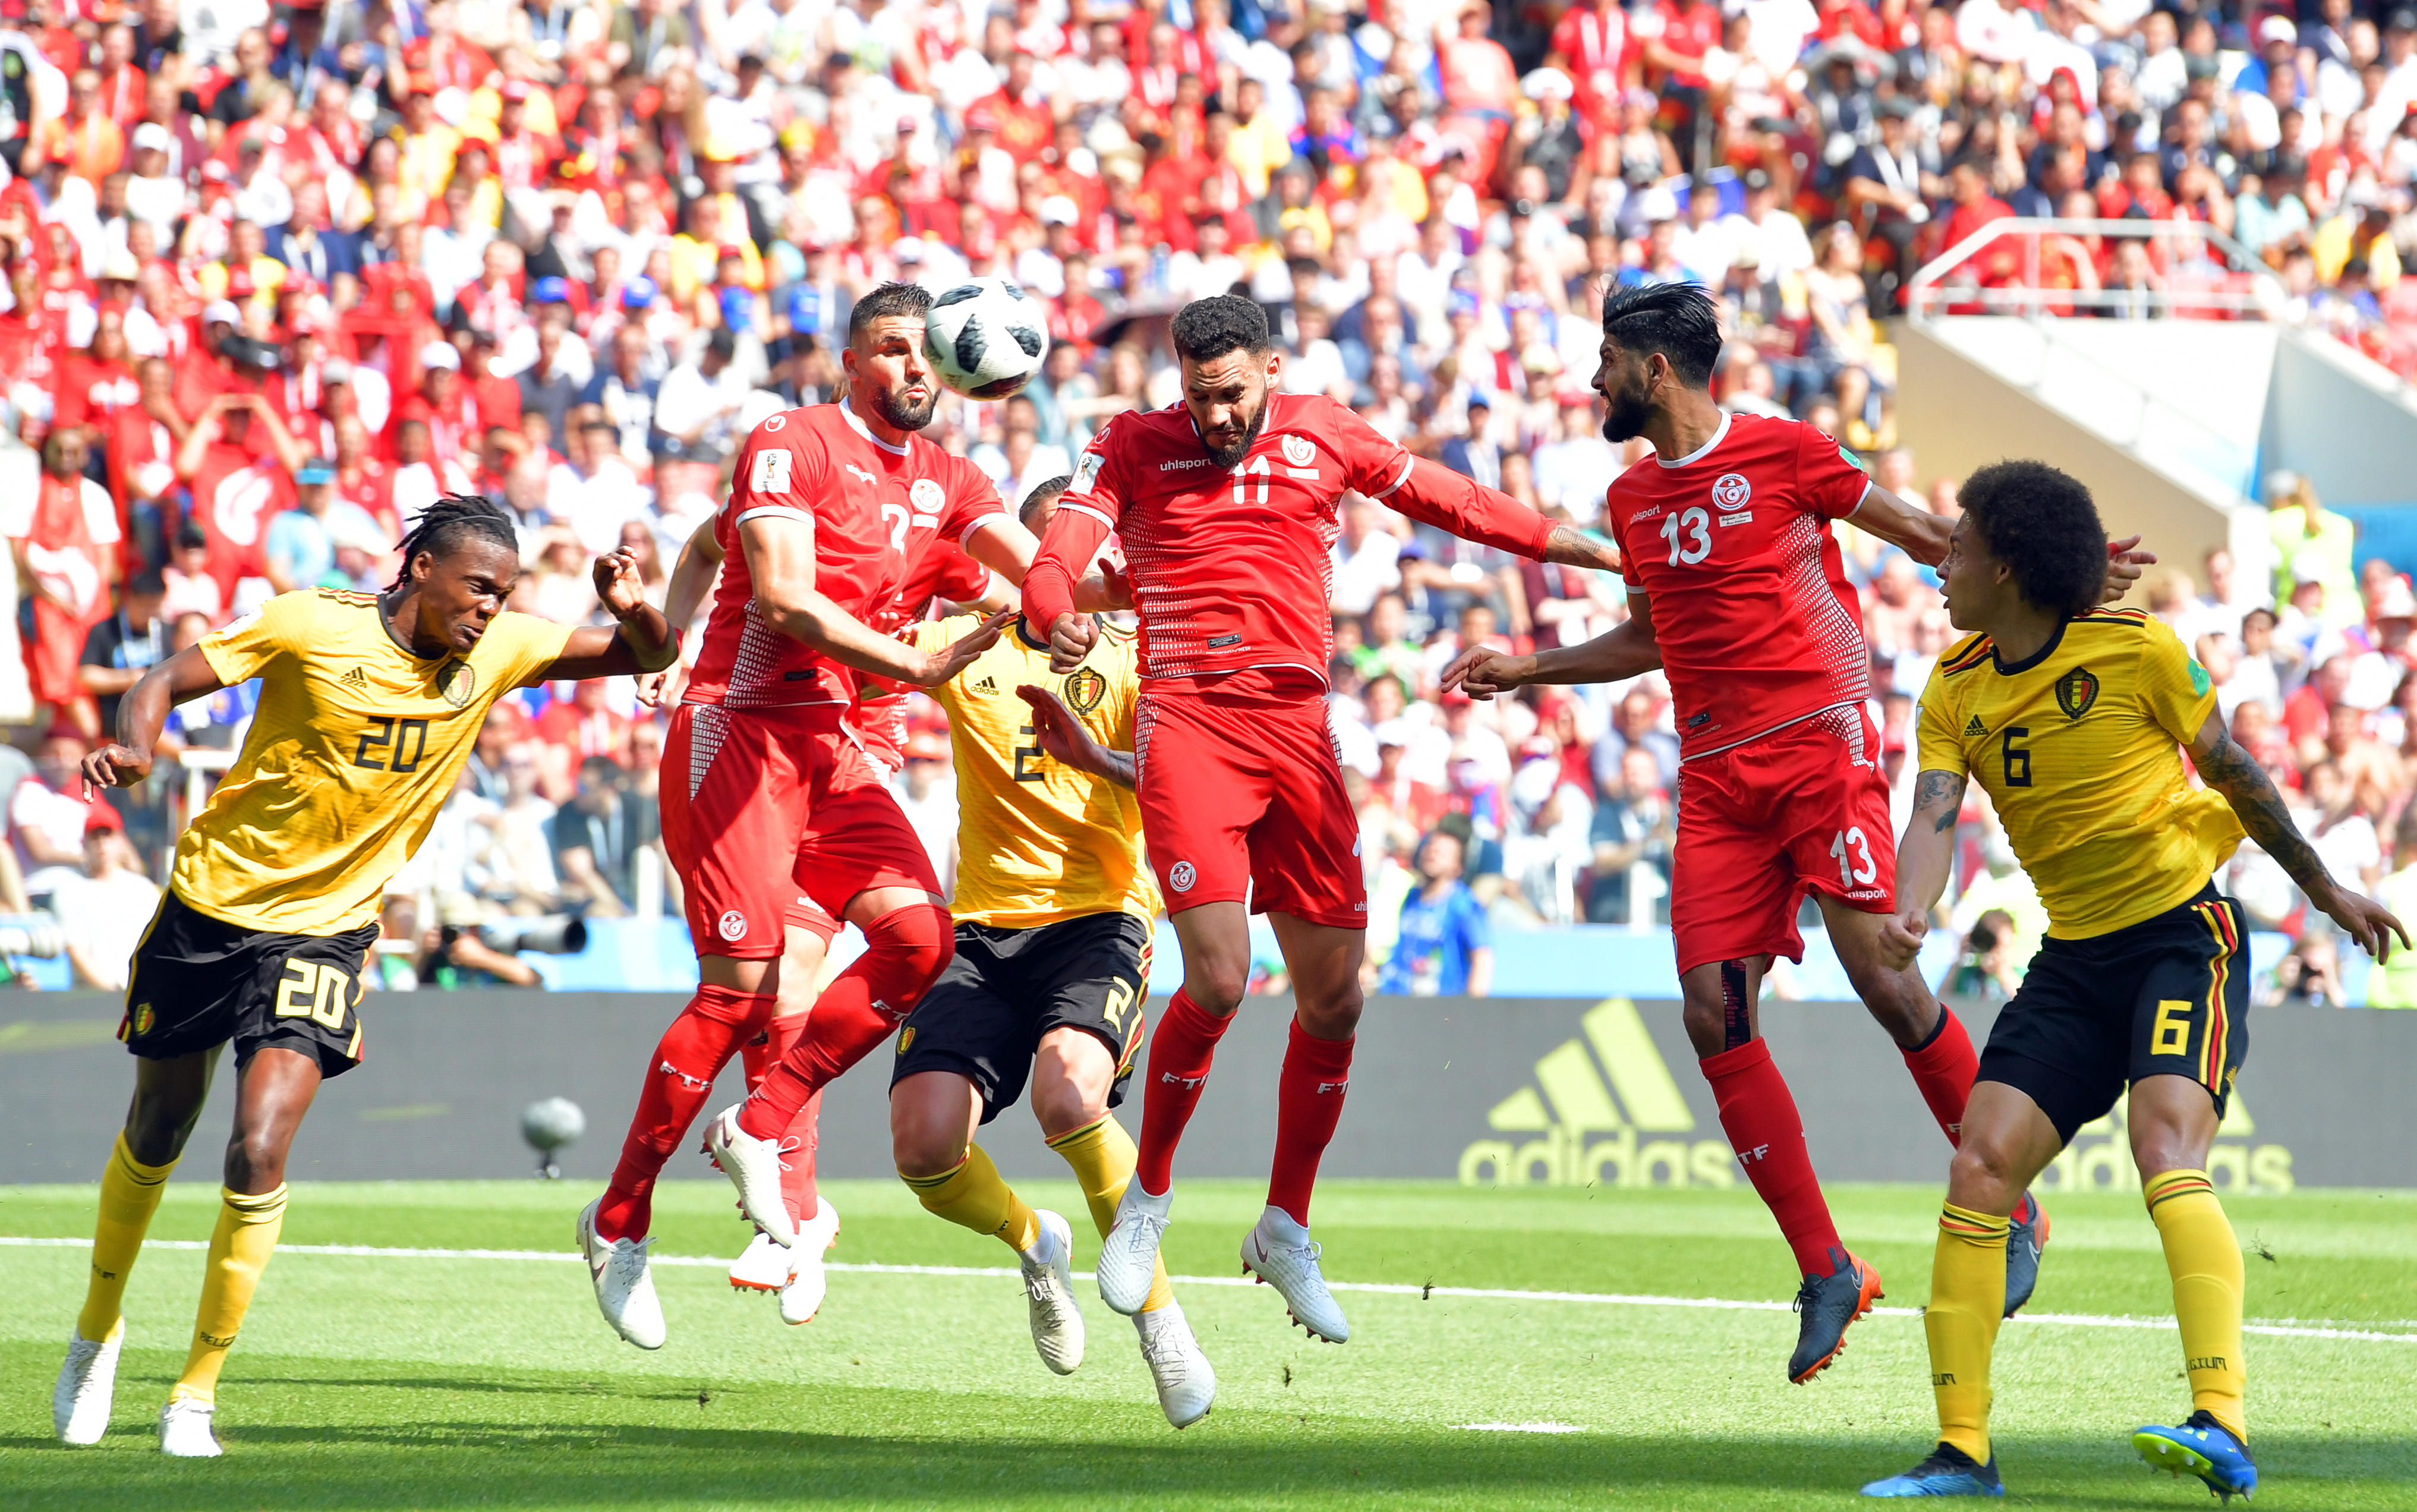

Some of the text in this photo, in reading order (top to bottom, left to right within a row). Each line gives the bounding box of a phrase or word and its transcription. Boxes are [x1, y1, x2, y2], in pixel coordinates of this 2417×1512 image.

[1159, 458, 1212, 471] uhlsport
[1227, 455, 1271, 505] 11
[1660, 506, 1712, 567] 13
[970, 686, 1000, 696] adidas
[354, 715, 430, 773] 20
[1014, 725, 1045, 782] 2
[2002, 726, 2032, 787] 6
[1829, 826, 1877, 888] 13
[275, 957, 351, 1029] 20
[1102, 976, 1135, 1034] 2
[2150, 999, 2193, 1057] 6
[1316, 1079, 1348, 1095] FT
[1458, 1122, 1737, 1188] adidas
[1737, 1144, 1769, 1165] TF
[2188, 1356, 2227, 1371] GIUM
